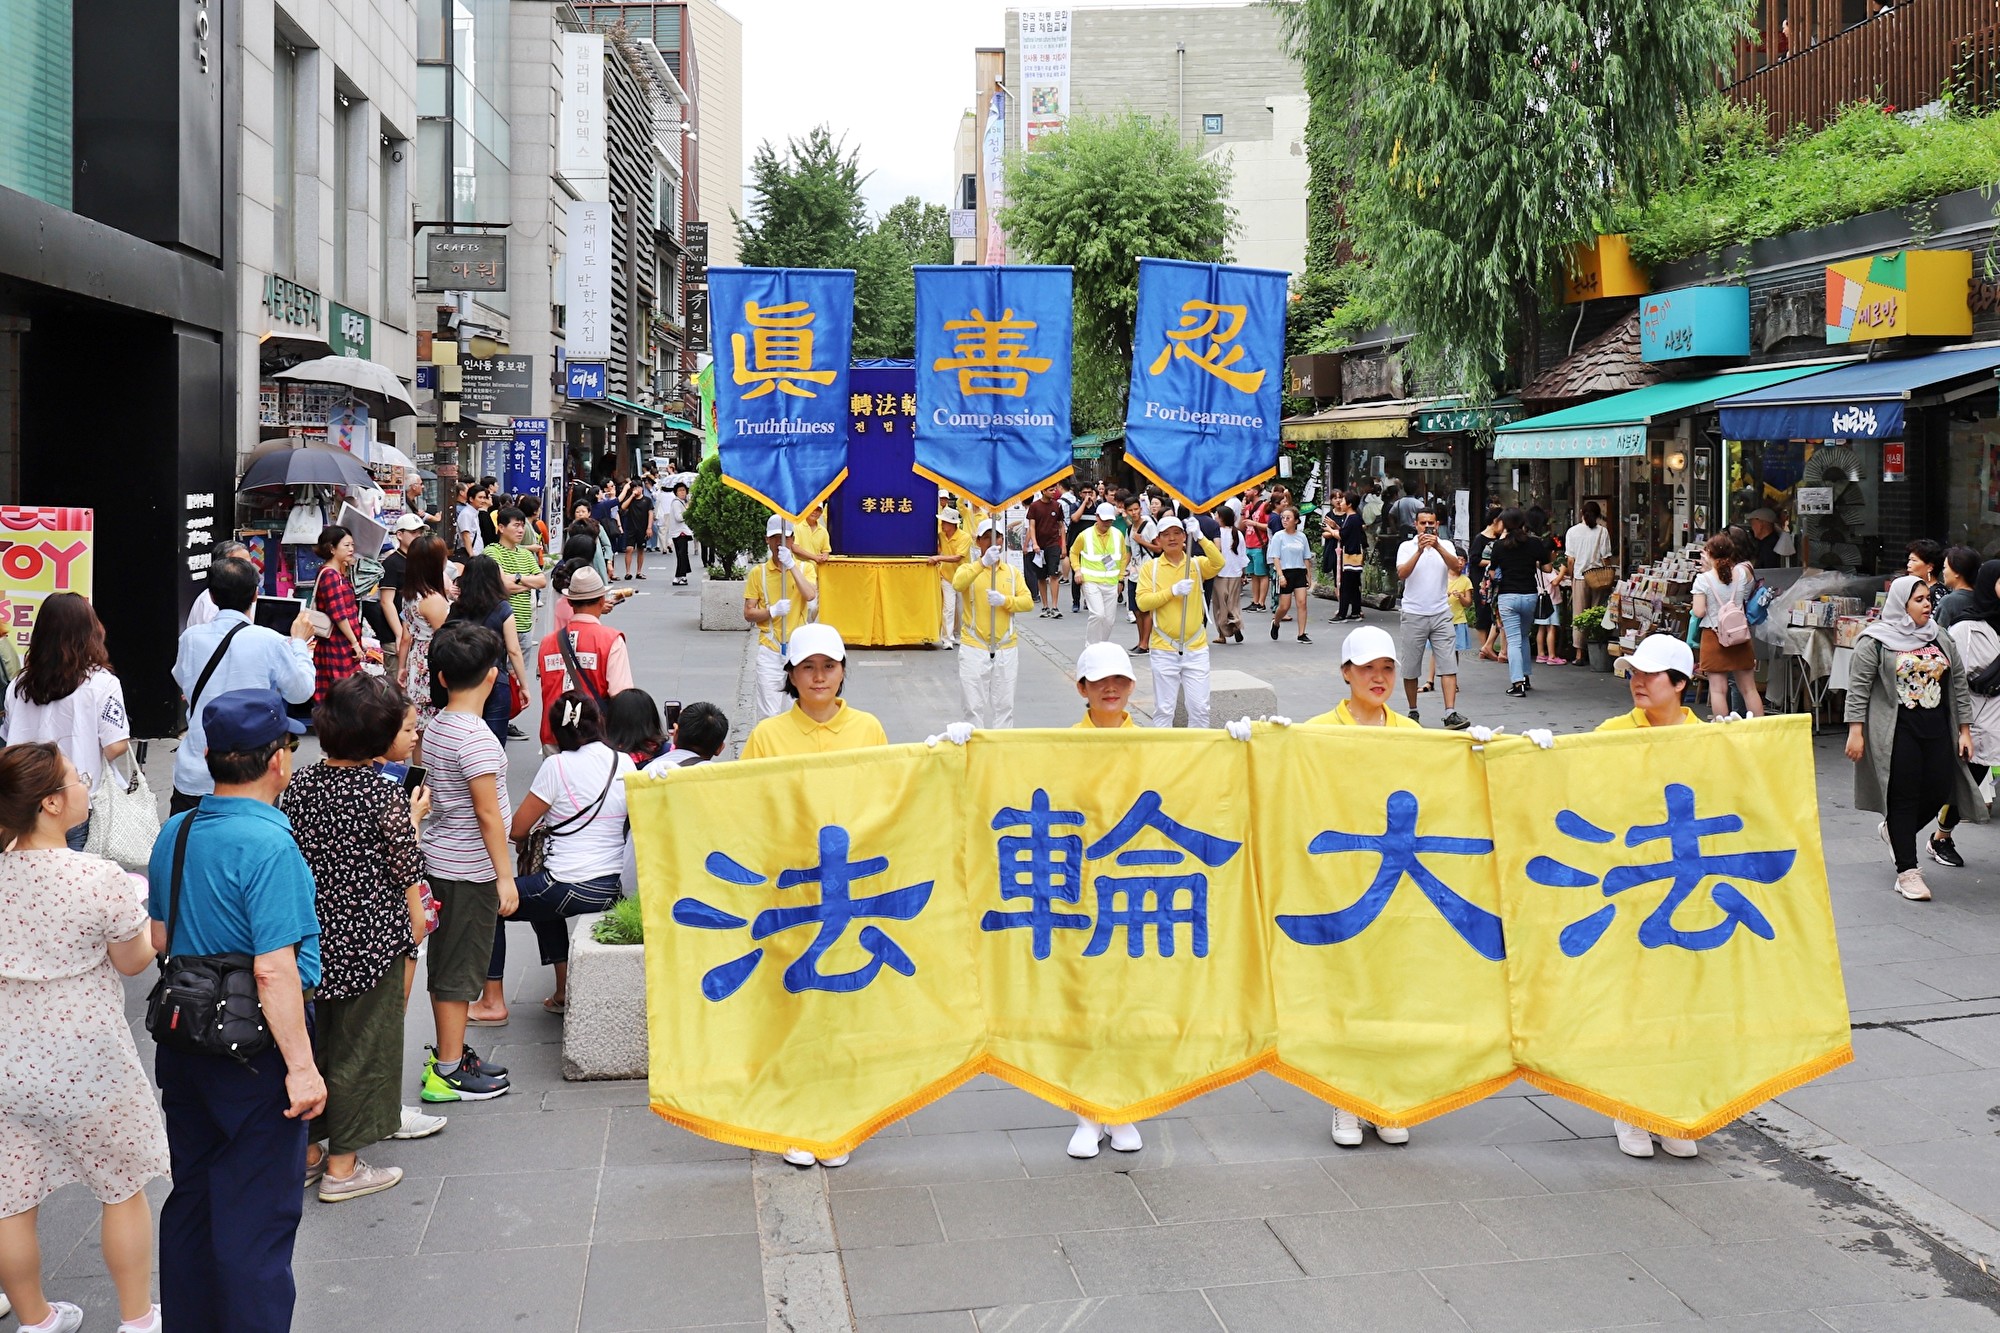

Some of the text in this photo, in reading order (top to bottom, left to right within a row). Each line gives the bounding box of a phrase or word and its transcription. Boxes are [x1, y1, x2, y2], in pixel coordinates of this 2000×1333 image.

[436, 243, 480, 251] CRAFTS
[451, 259, 497, 285] 아원
[1858, 295, 1898, 328] 세로방
[933, 308, 1053, 397] 善
[1149, 299, 1266, 394] 忍
[464, 360, 526, 373] 인사동 홍보관
[735, 417, 836, 436] Truthfulness
[933, 407, 1055, 429] Compassion
[1145, 401, 1263, 429] Forbearance
[1832, 405, 1878, 435] 세로방
[1617, 433, 1640, 449] 사보당
[1408, 458, 1449, 467] 아원공방
[862, 497, 913, 512] 李洪志
[0, 541, 88, 589] OY
[671, 783, 1796, 1002] 法輪大法
